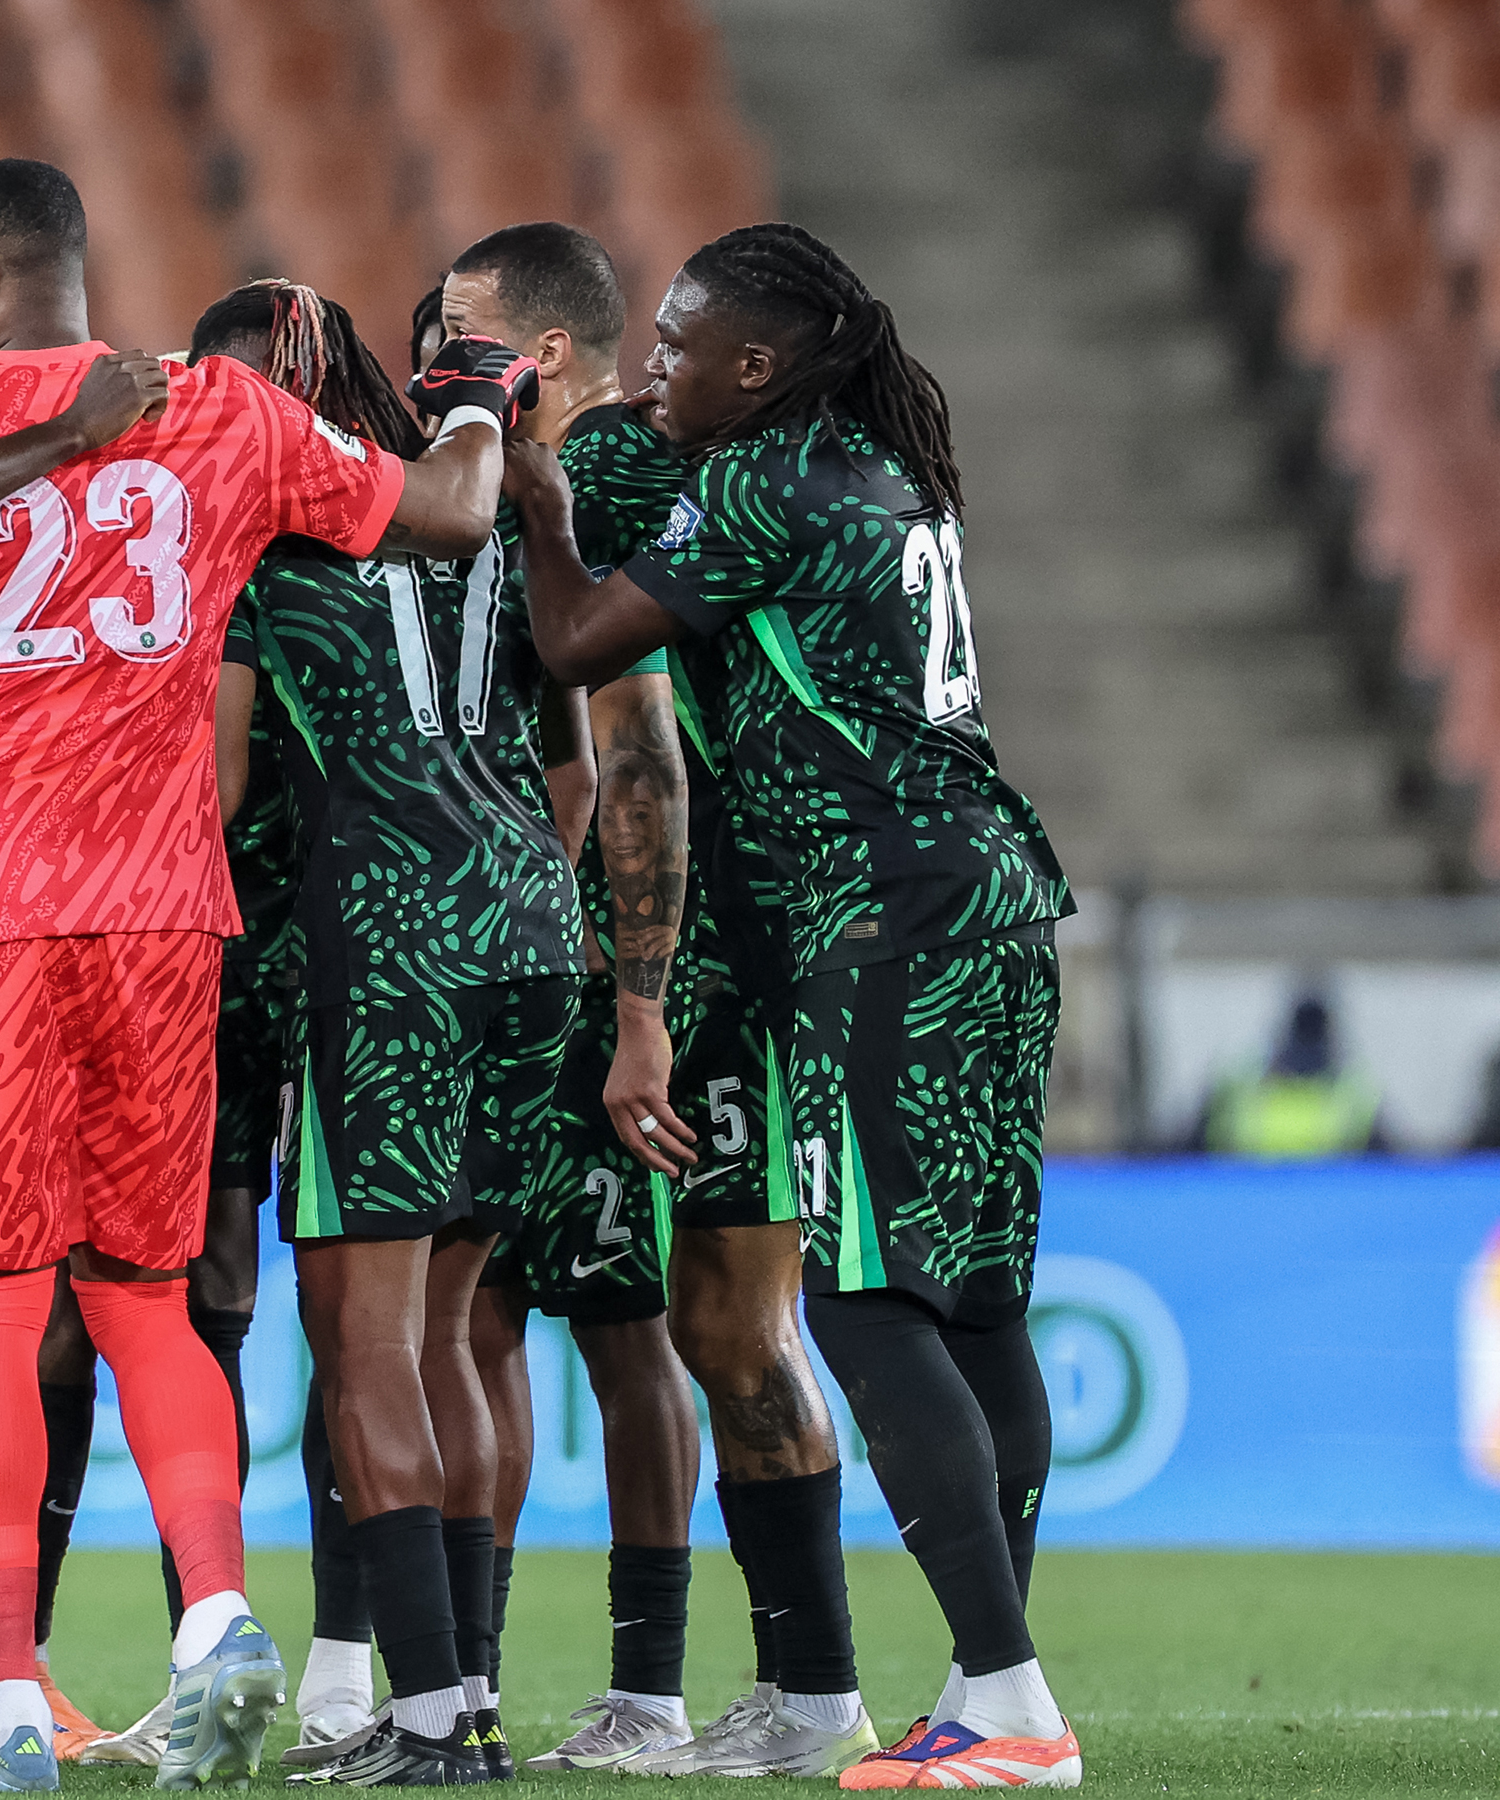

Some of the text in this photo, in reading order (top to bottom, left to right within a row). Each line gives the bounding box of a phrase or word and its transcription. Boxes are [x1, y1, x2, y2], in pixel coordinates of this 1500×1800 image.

[902, 504, 981, 726] 21
[707, 1076, 749, 1155] 5
[586, 1168, 632, 1246] 2
[1021, 1487, 1040, 1519] NFF
